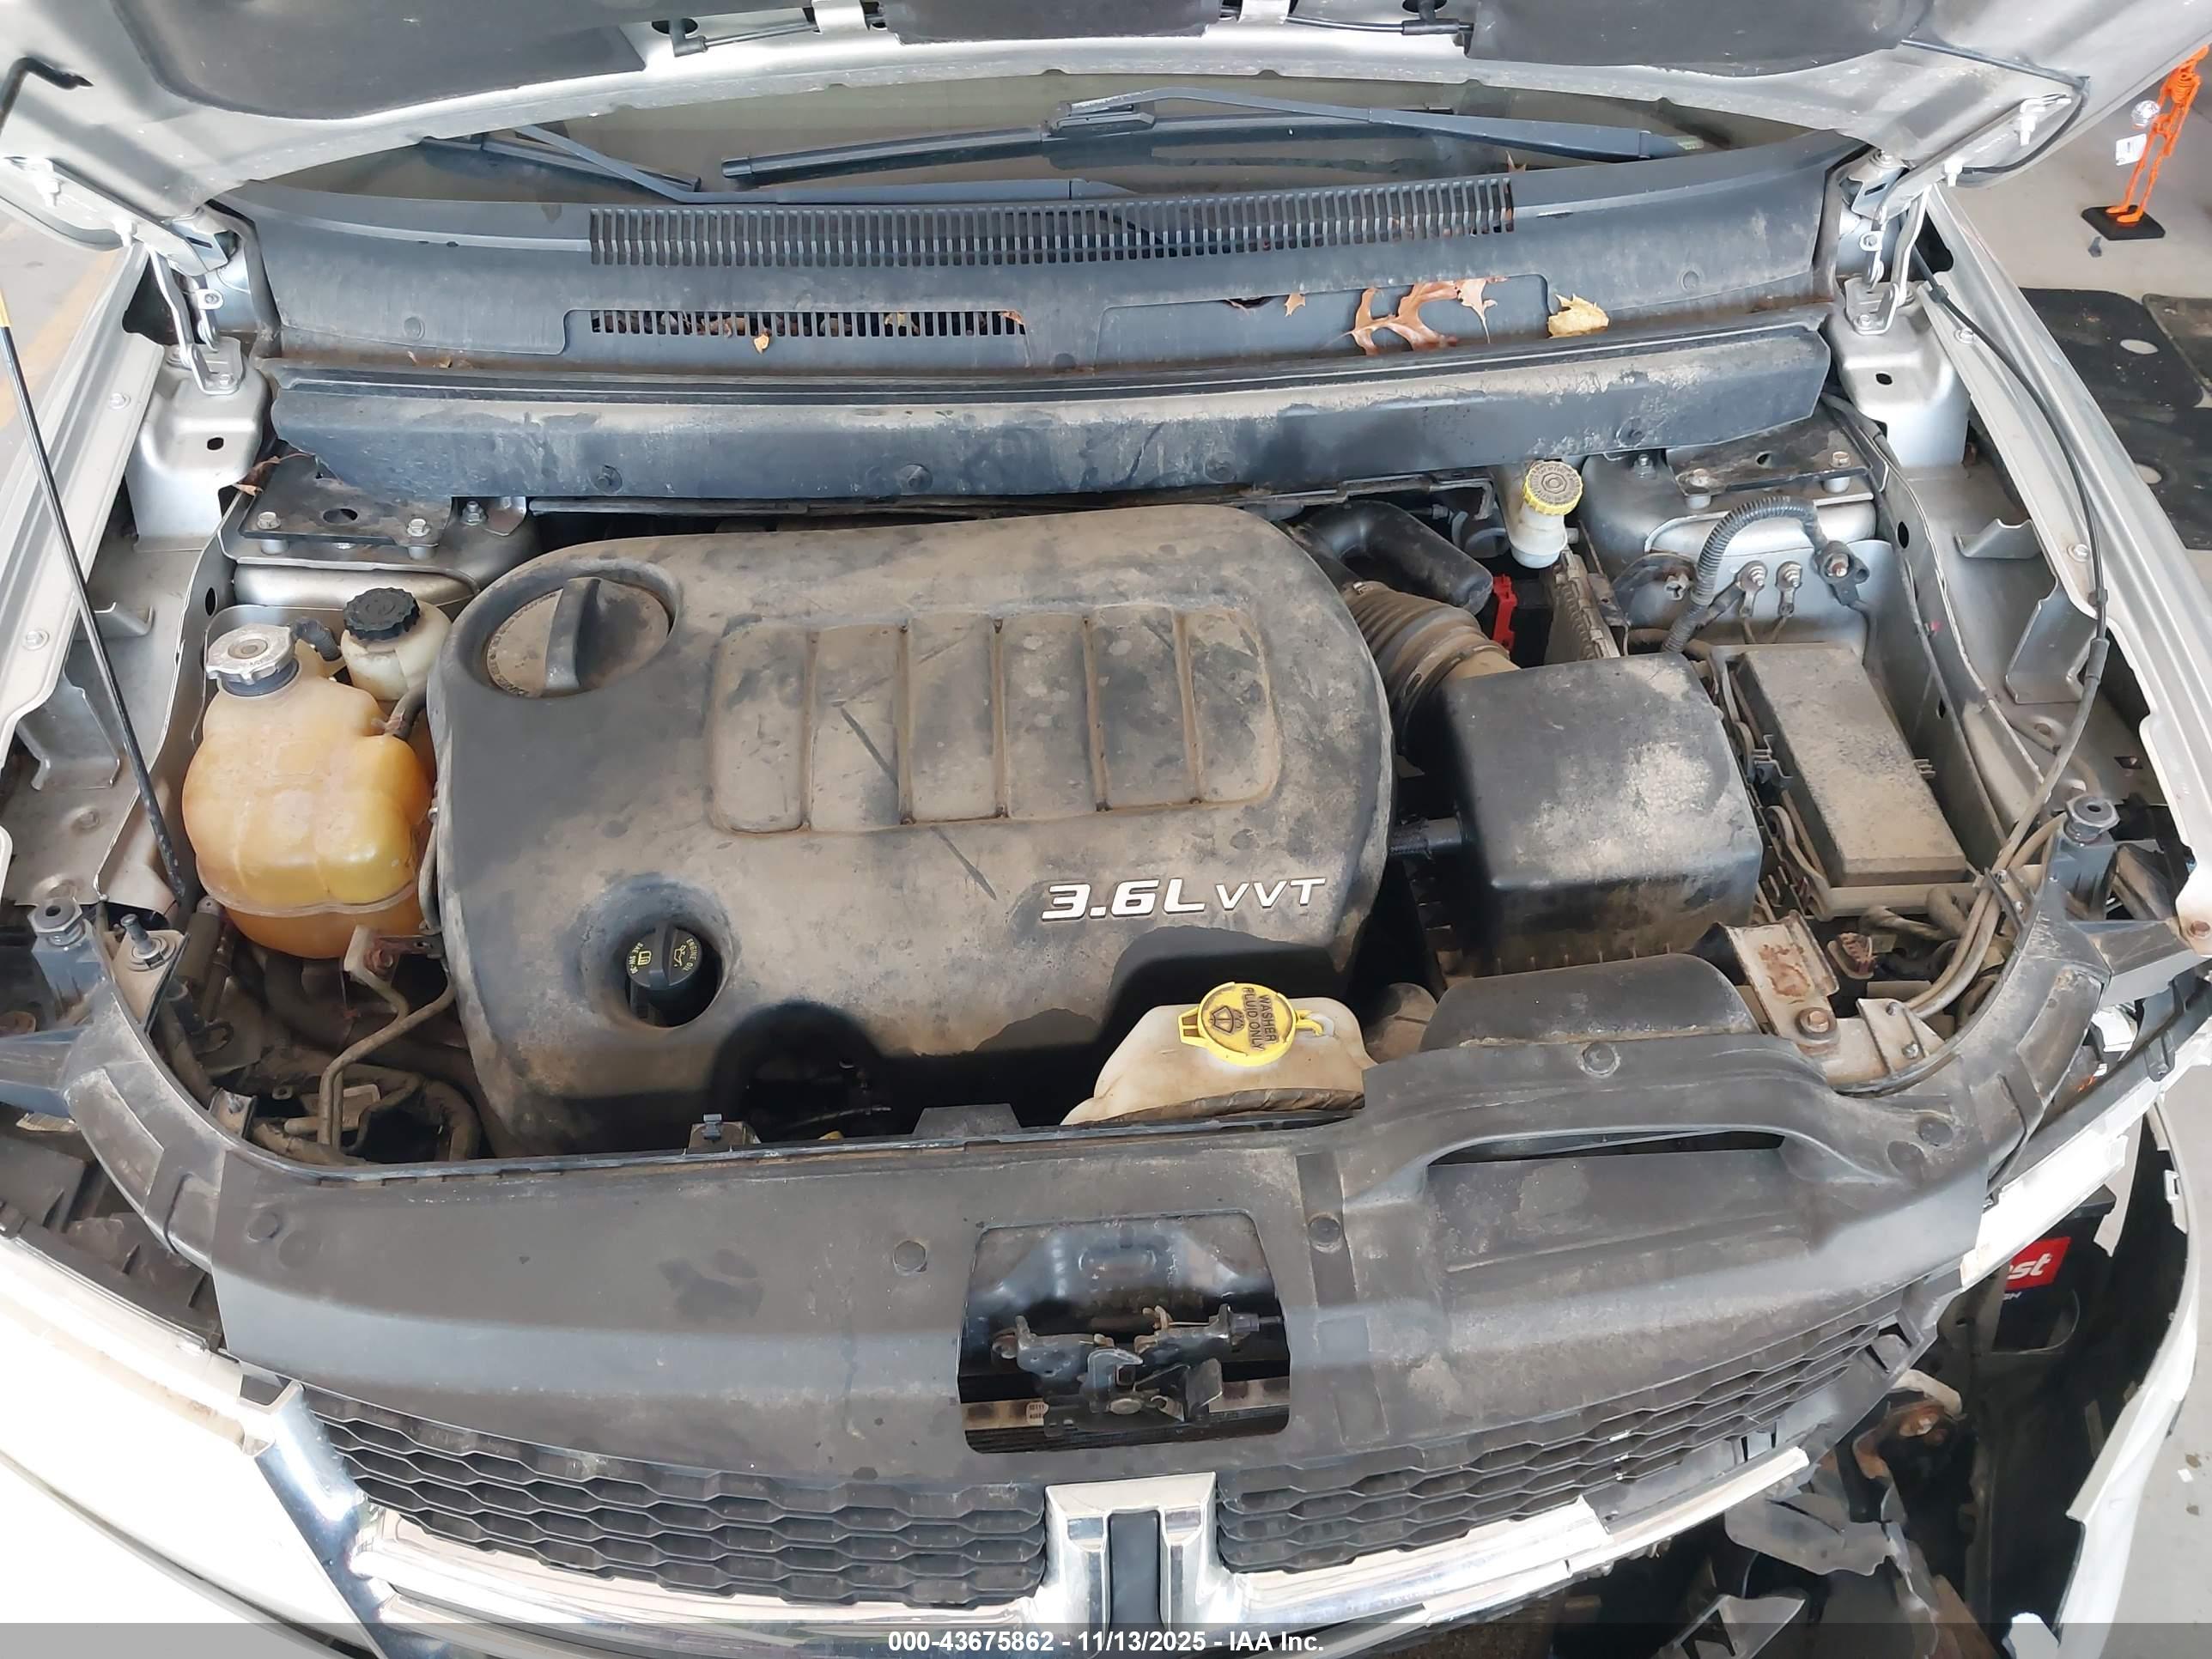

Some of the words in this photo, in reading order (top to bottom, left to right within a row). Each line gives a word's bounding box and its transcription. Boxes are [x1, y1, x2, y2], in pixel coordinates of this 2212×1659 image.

[1041, 878, 1206, 921] 3.6L
[1214, 878, 1327, 911] VVT
[686, 939, 697, 960] ENGINE
[683, 962, 693, 971] OIL
[1243, 987, 1259, 1018] FLUID
[1258, 994, 1278, 1043] WASHER
[1249, 1021, 1267, 1051] ONLY
